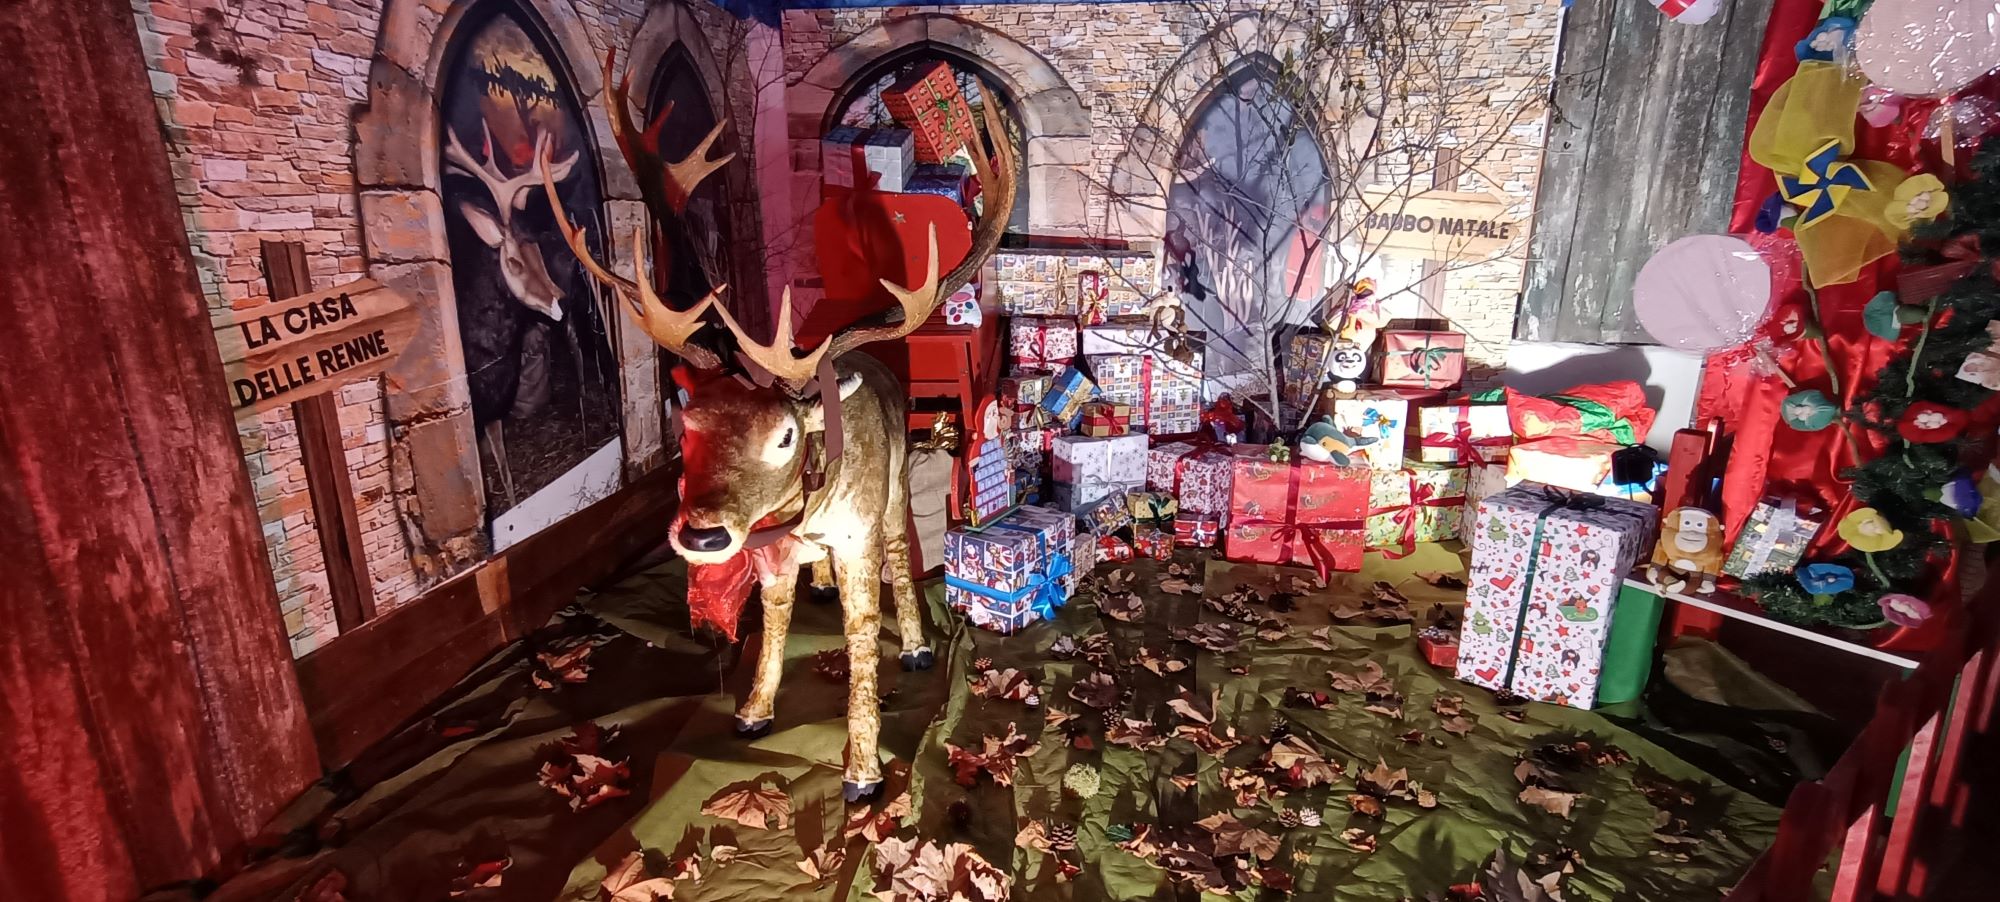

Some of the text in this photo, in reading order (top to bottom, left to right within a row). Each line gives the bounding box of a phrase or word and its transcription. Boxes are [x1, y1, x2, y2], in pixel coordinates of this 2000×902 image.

[1364, 212, 1511, 239] BABBO NATALE
[241, 292, 358, 349] LA CASA
[233, 330, 389, 407] DELLE RENNE
